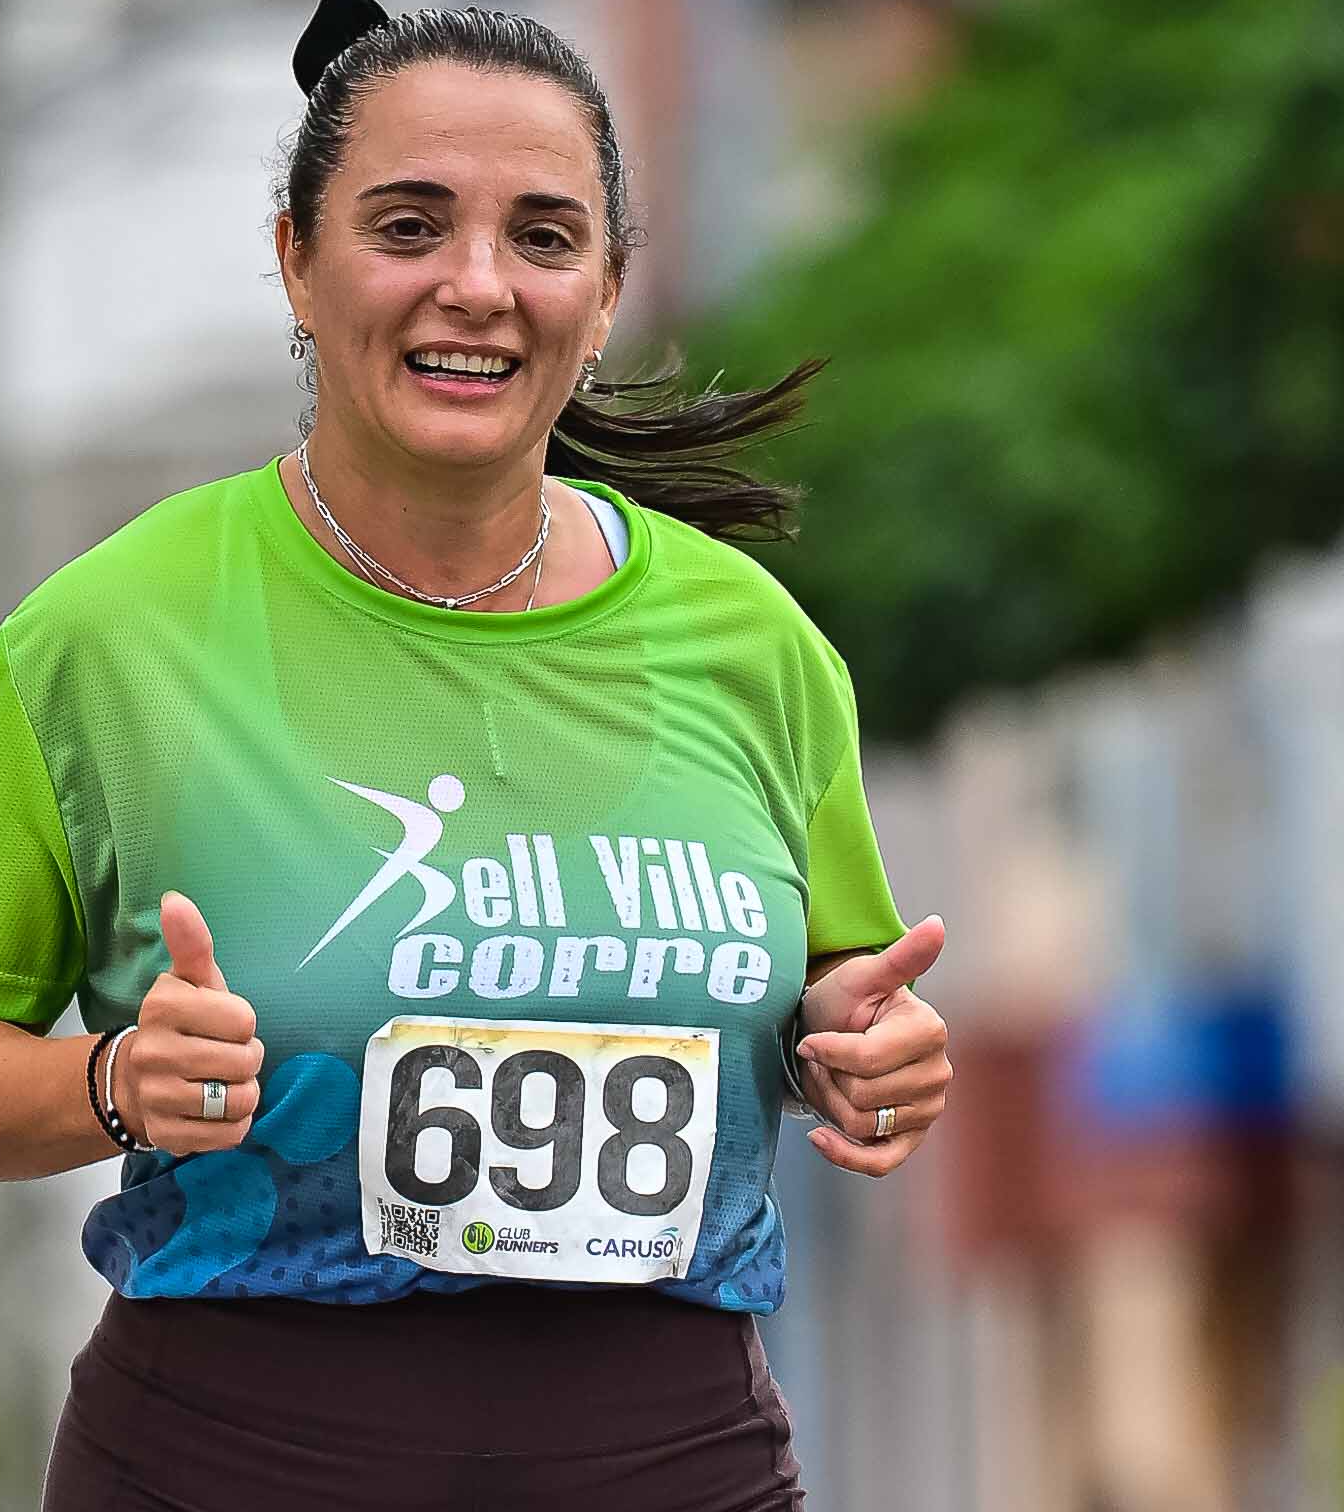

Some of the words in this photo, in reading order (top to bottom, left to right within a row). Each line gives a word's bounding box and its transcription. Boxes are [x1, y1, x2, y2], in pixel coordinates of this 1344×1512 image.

[589, 835, 768, 938] Ville
[387, 933, 772, 1004] corre
[384, 1045, 695, 1216] 698
[494, 1239, 560, 1255] RUNNER'S
[497, 1226, 531, 1240] CLUB
[586, 1238, 674, 1258] CARUSO
